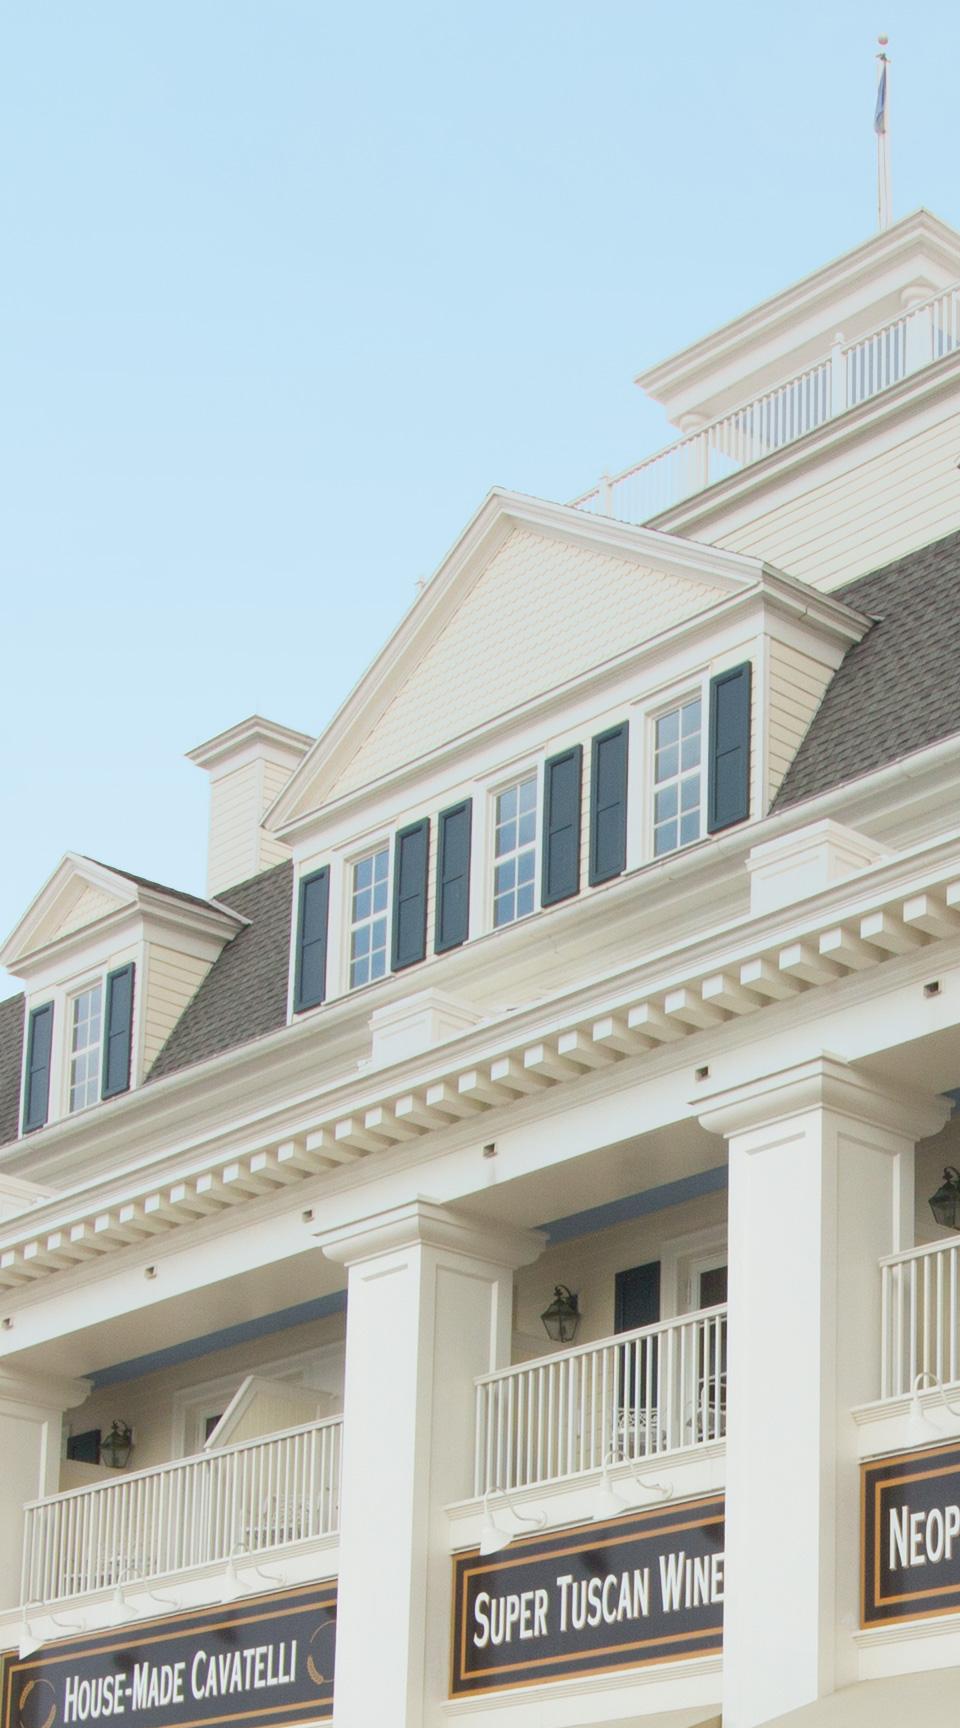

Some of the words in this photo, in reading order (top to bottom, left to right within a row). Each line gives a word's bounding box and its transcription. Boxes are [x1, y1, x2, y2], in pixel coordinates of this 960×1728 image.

[473, 1589, 549, 1648] SUPER
[556, 1568, 650, 1632] TUSCAN
[659, 1551, 725, 1612] WINE
[64, 1661, 186, 1723] HOUSE-MADE
[191, 1640, 298, 1700] CAVATELLI
